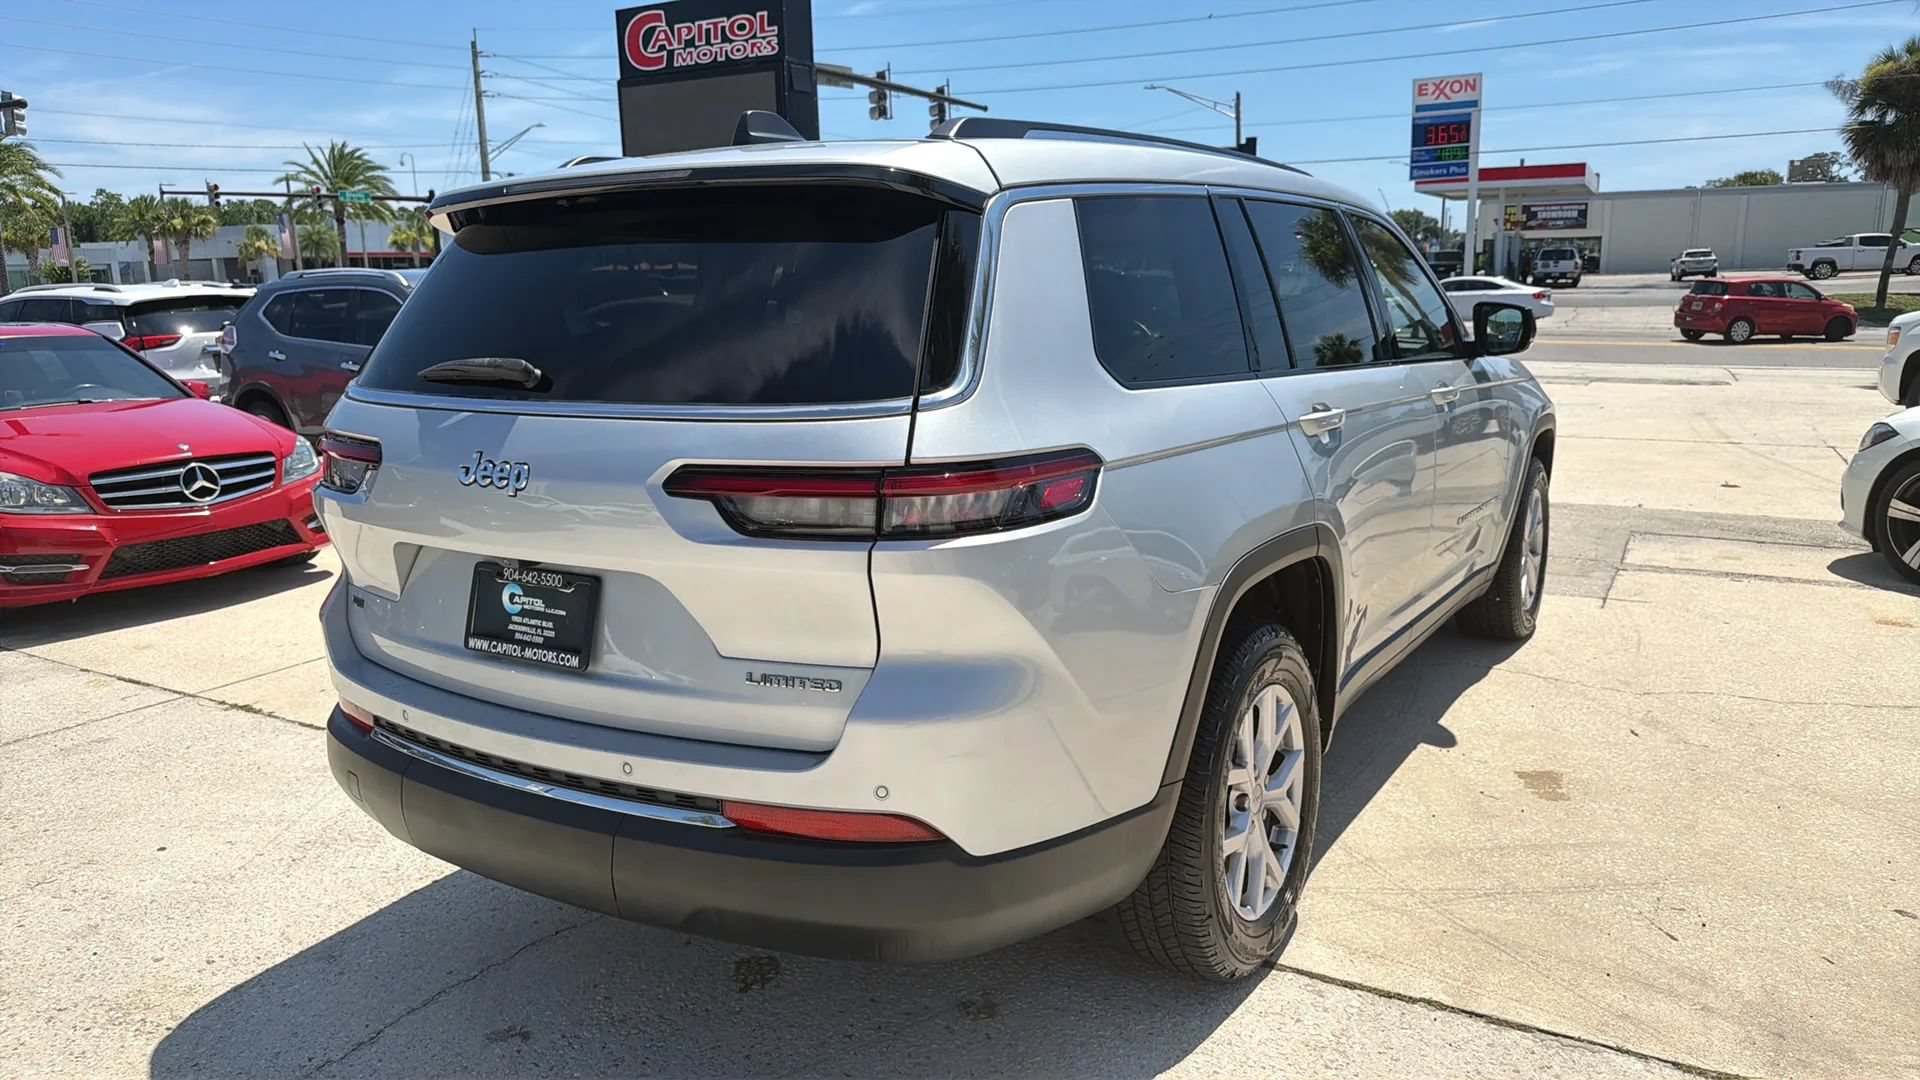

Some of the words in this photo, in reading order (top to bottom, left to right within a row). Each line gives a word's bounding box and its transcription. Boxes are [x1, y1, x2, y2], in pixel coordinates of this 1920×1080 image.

[625, 10, 778, 71] CAPITOL
[673, 38, 779, 67] MOTORS
[1417, 78, 1477, 100] EXXON
[1412, 167, 1447, 177] Smokers
[1449, 166, 1466, 174] Plus
[458, 450, 530, 497] Jeep
[503, 568, 563, 587] 904-642-5500
[502, 583, 545, 614] CAPITOL
[523, 604, 545, 613] MOTORS
[522, 617, 542, 627] ATLANTIC
[537, 627, 543, 636] FL
[468, 637, 580, 668] WWW.CAPITOL-MOTORS.COM
[745, 671, 842, 692] LIMITED
